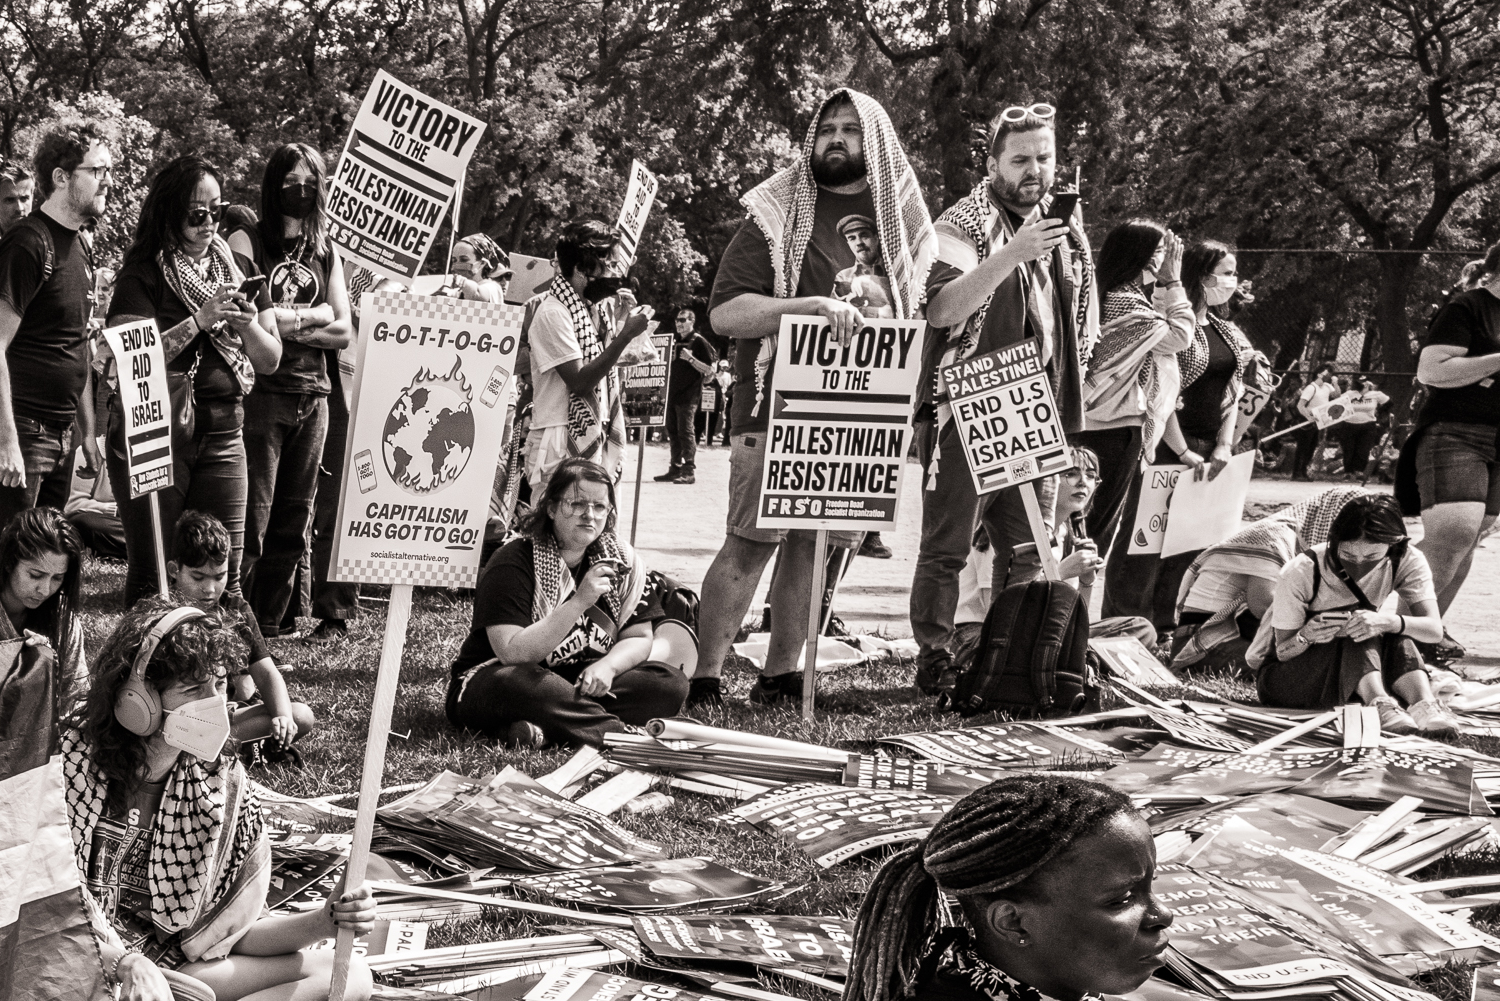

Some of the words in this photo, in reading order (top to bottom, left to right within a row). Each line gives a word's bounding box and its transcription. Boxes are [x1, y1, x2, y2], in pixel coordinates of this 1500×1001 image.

[371, 79, 477, 157] VICTORY
[388, 129, 405, 150] TO
[405, 138, 430, 163] THE
[338, 158, 442, 228] PALESTINIAN
[328, 186, 430, 256] RESISTANCE
[119, 328, 142, 352] END
[143, 326, 156, 347] US
[373, 321, 515, 355] G-O-T-T-O-G-O
[132, 353, 151, 380] AID
[944, 357, 994, 382] STAND
[997, 341, 1037, 365] WITH
[948, 357, 1042, 398] PALESTINE!
[138, 380, 150, 402] TO
[822, 369, 840, 389] TO
[844, 370, 871, 391] THE
[131, 400, 164, 428] ISRAEL
[958, 395, 1002, 422] END
[1008, 381, 1045, 405] U.S
[968, 416, 1009, 445] AID
[1016, 403, 1051, 428] TO
[770, 425, 904, 457] PALESTINIAN
[971, 424, 1060, 466] ISRAEL!
[766, 460, 900, 494] RESISTANCE
[365, 502, 469, 525] CAPITALISM
[824, 508, 848, 516] Socialist
[848, 509, 885, 518] Organization
[825, 500, 850, 508] Freedom
[850, 500, 864, 508] Road
[348, 520, 383, 538] HAS
[384, 523, 422, 541] GOT
[423, 525, 445, 543] TO
[448, 528, 480, 545] GO!
[370, 551, 450, 564] socialistalternative.org
